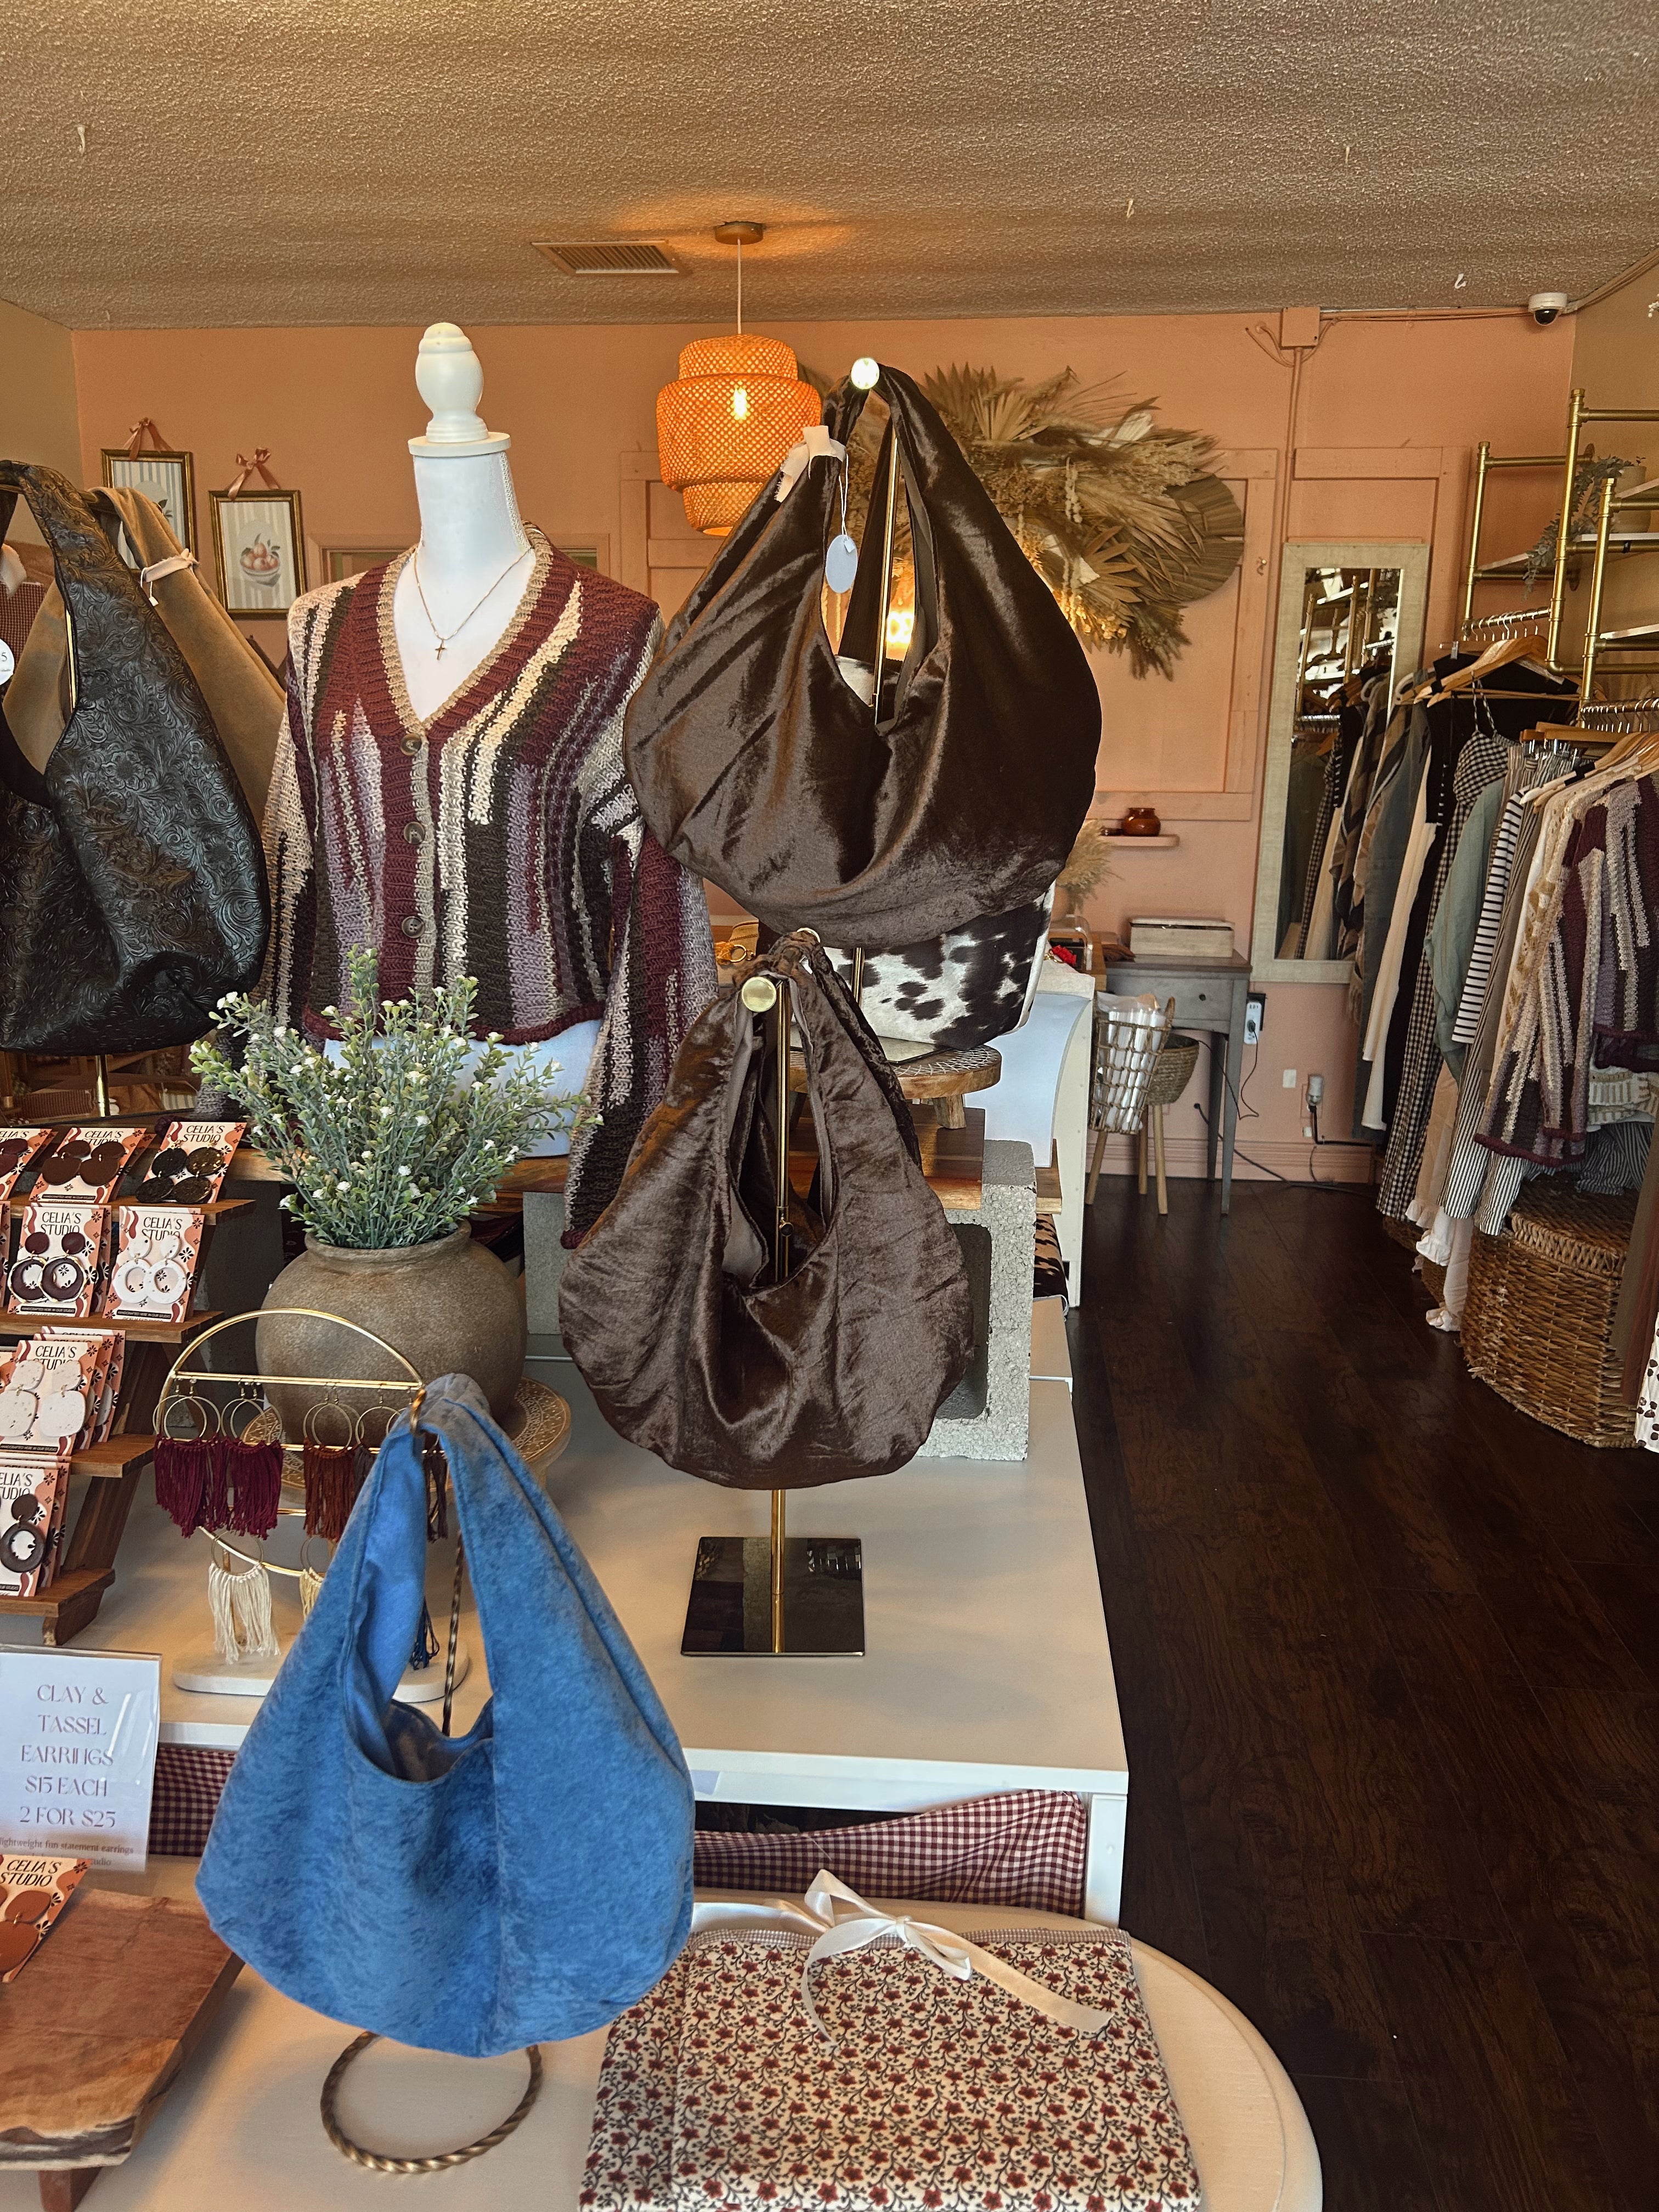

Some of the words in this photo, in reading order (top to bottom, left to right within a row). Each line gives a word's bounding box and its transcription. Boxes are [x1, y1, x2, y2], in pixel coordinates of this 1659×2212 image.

[84, 1130, 123, 1138] CELIA'S
[186, 1125, 225, 1134] CELIA'S
[182, 1134, 222, 1142] STUDIO
[42, 1211, 82, 1224] CELIA'S
[143, 1216, 183, 1230] CELIA'S
[36, 1345, 77, 1358] CELIA'S
[0, 1472, 33, 1486] ELIA'S
[37, 1684, 86, 1704] CLAY
[92, 1686, 109, 1705] &
[37, 1714, 106, 1736] TASSEL
[21, 1745, 114, 1766] EARRINGS
[25, 1775, 53, 1794] $15
[58, 1777, 108, 1797] EACH
[20, 1807, 30, 1823] 2
[36, 1808, 74, 1826] FOR
[82, 1810, 116, 1829] $25
[45, 1839, 59, 1848] fun
[61, 1842, 99, 1852] statement
[101, 1844, 134, 1854] earrings
[7, 1859, 62, 1875] CELIA'S
[0, 1871, 53, 1887] STUDIO
